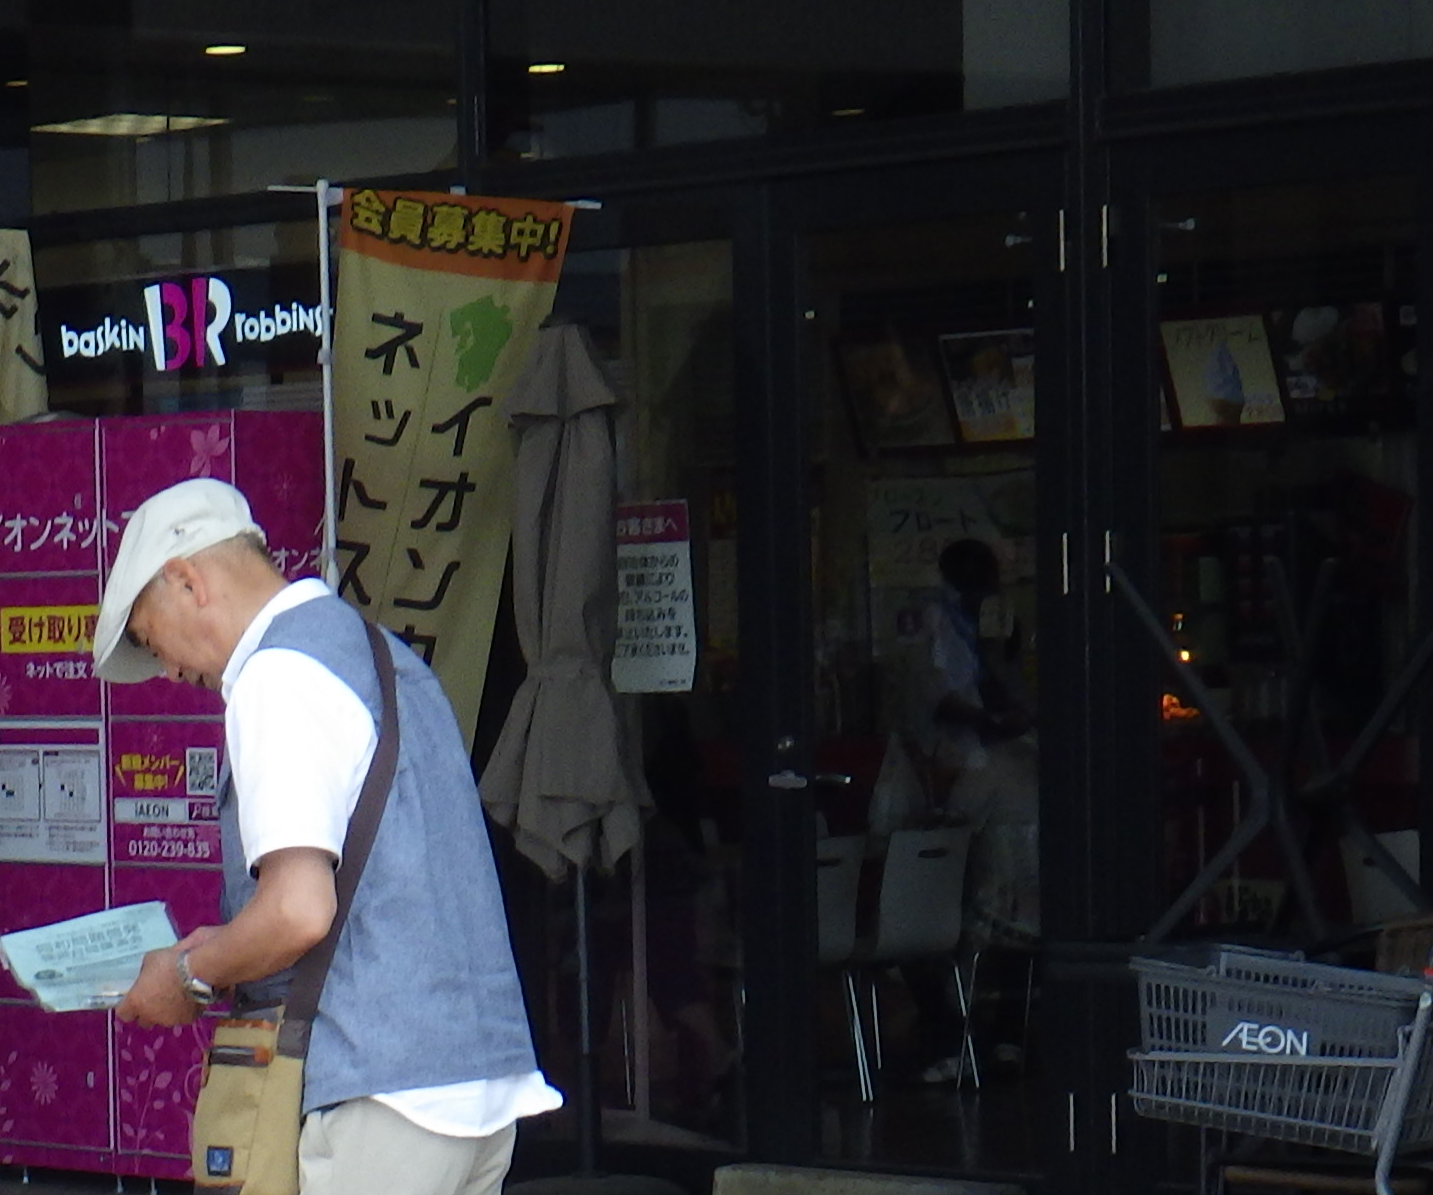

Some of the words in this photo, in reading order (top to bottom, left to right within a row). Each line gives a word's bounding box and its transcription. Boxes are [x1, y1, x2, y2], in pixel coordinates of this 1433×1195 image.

[351, 189, 562, 262] 会員募集中!
[60, 316, 145, 358] baskin
[144, 276, 232, 371] BR
[234, 301, 324, 343] robbins
